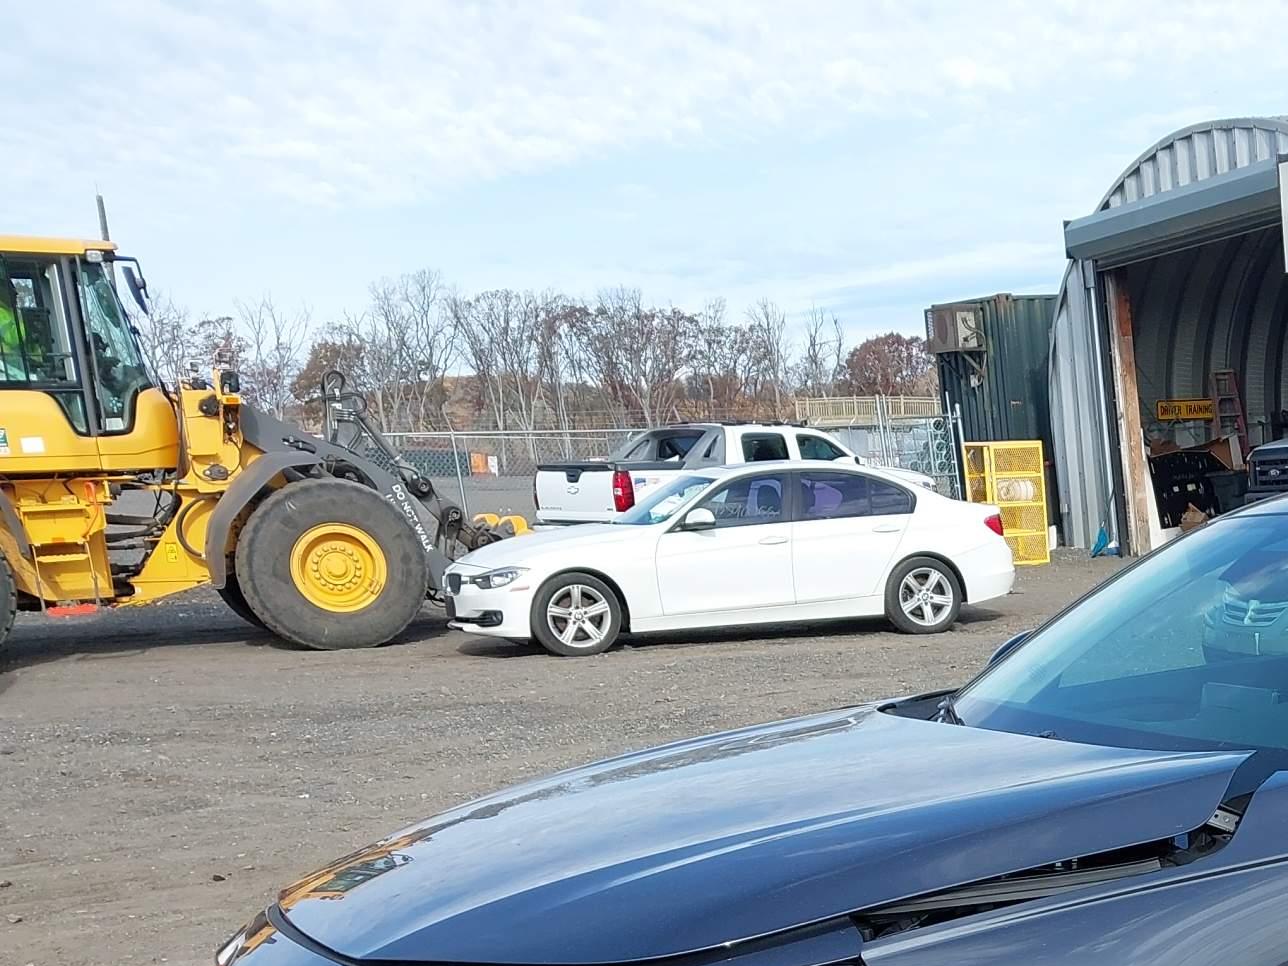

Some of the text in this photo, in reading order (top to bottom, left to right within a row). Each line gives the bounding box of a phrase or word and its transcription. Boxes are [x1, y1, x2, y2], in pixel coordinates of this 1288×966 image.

[1160, 405, 1182, 416] DRIVER
[392, 484, 433, 552] DO NOT WALK
